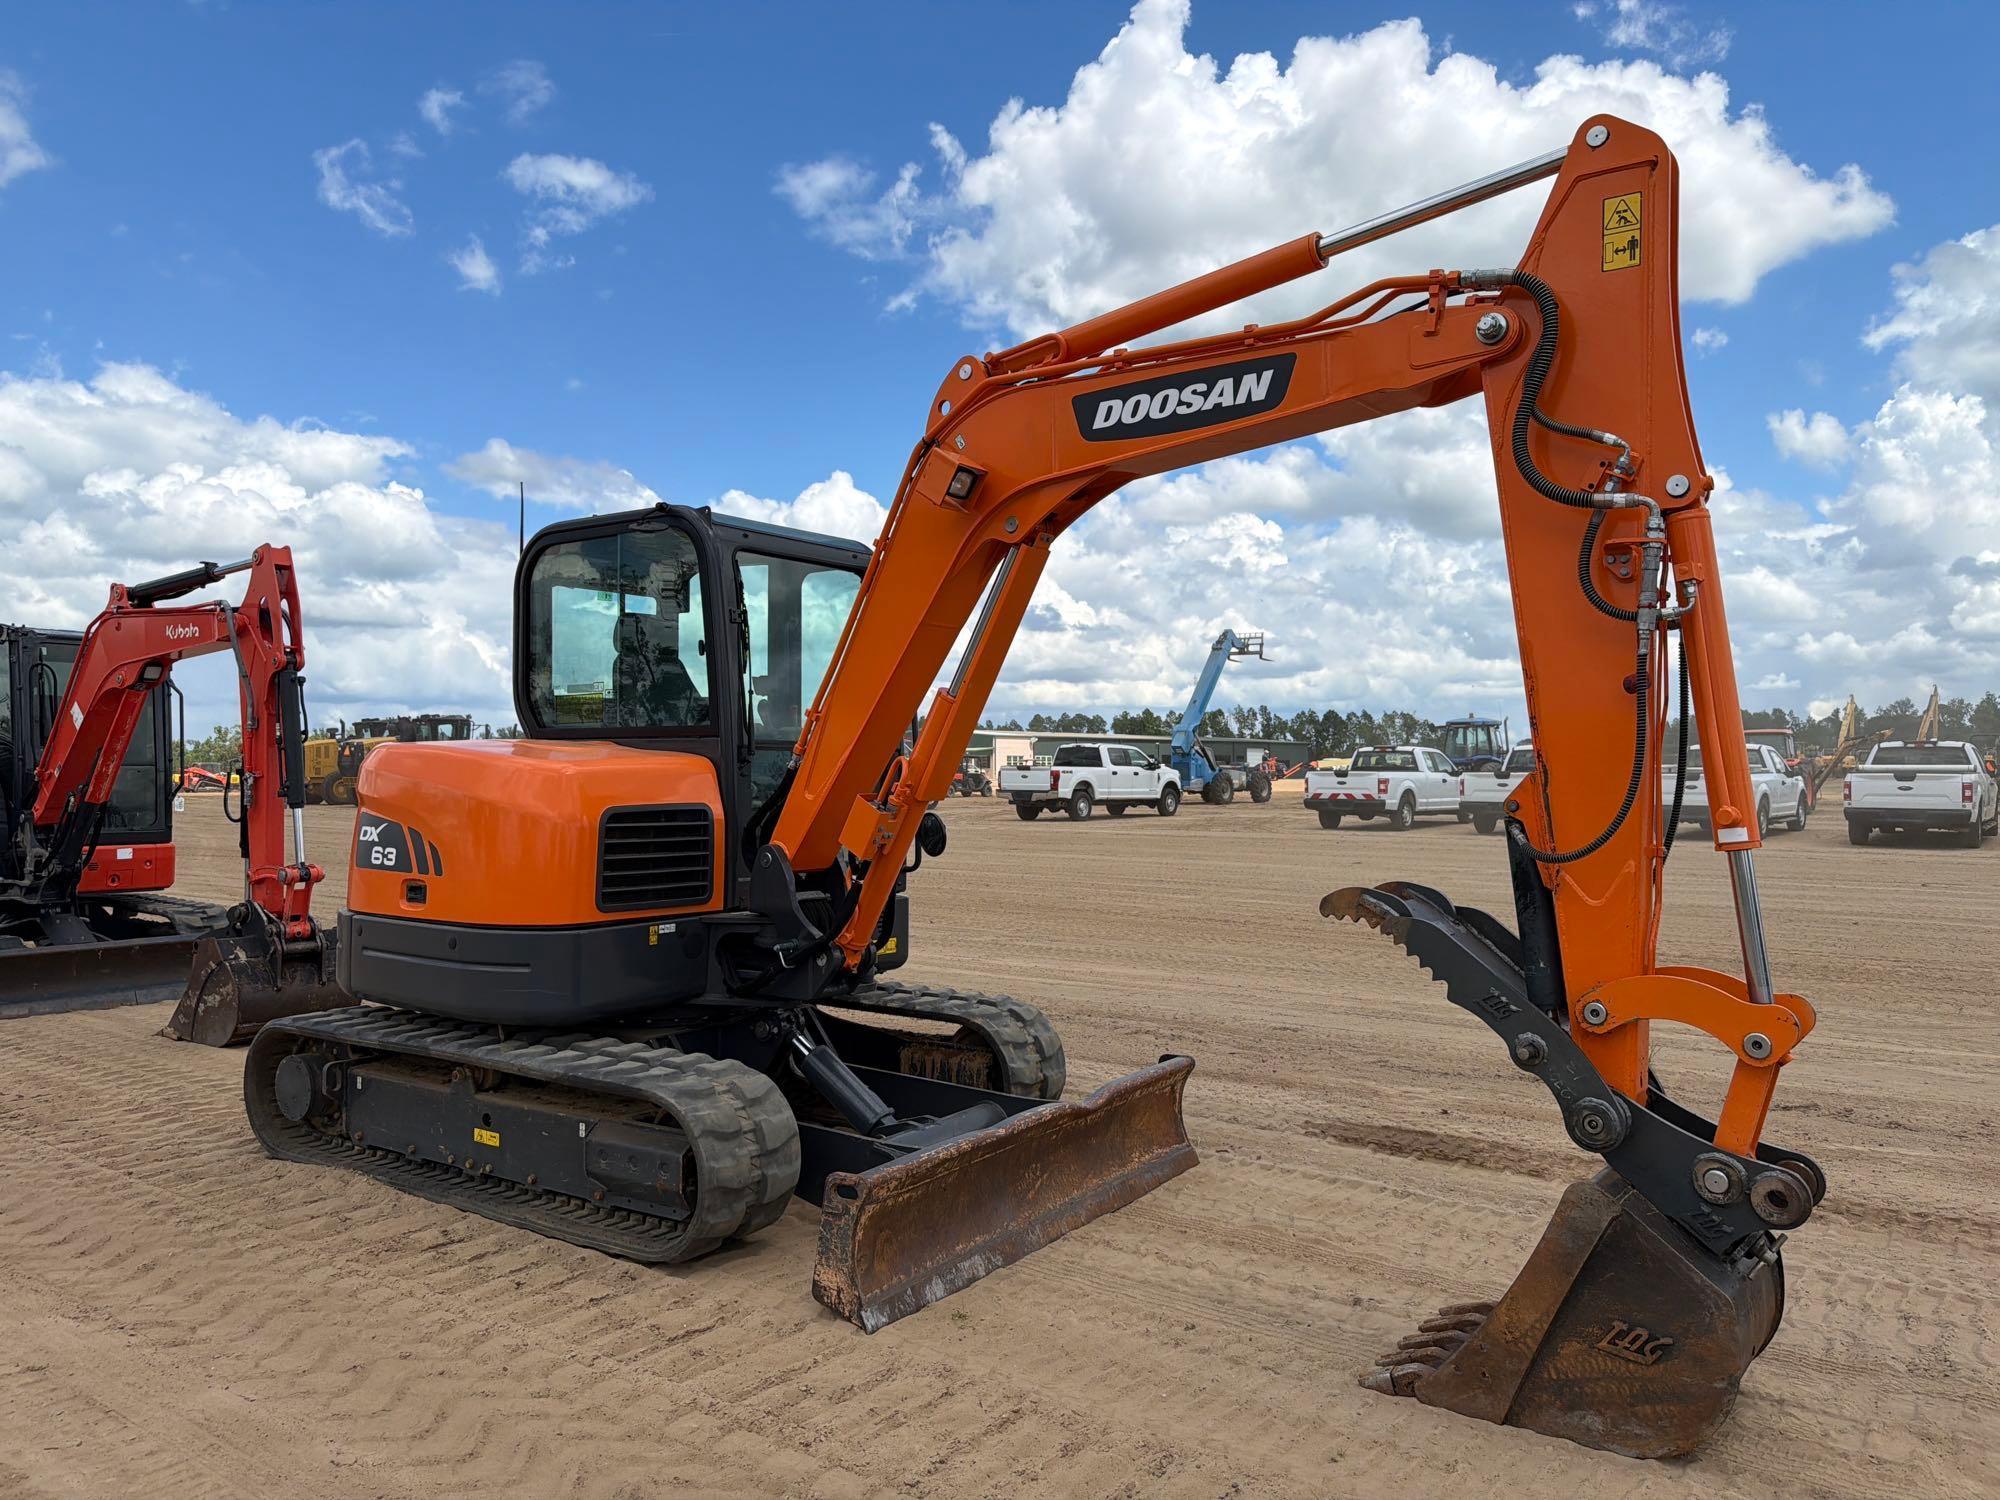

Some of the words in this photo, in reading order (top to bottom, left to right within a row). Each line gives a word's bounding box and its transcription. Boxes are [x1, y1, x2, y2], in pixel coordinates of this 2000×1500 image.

[1092, 369, 1274, 430] DOOSAN
[166, 623, 199, 640] Kubota
[360, 823, 388, 842] DX
[371, 846, 396, 866] 63
